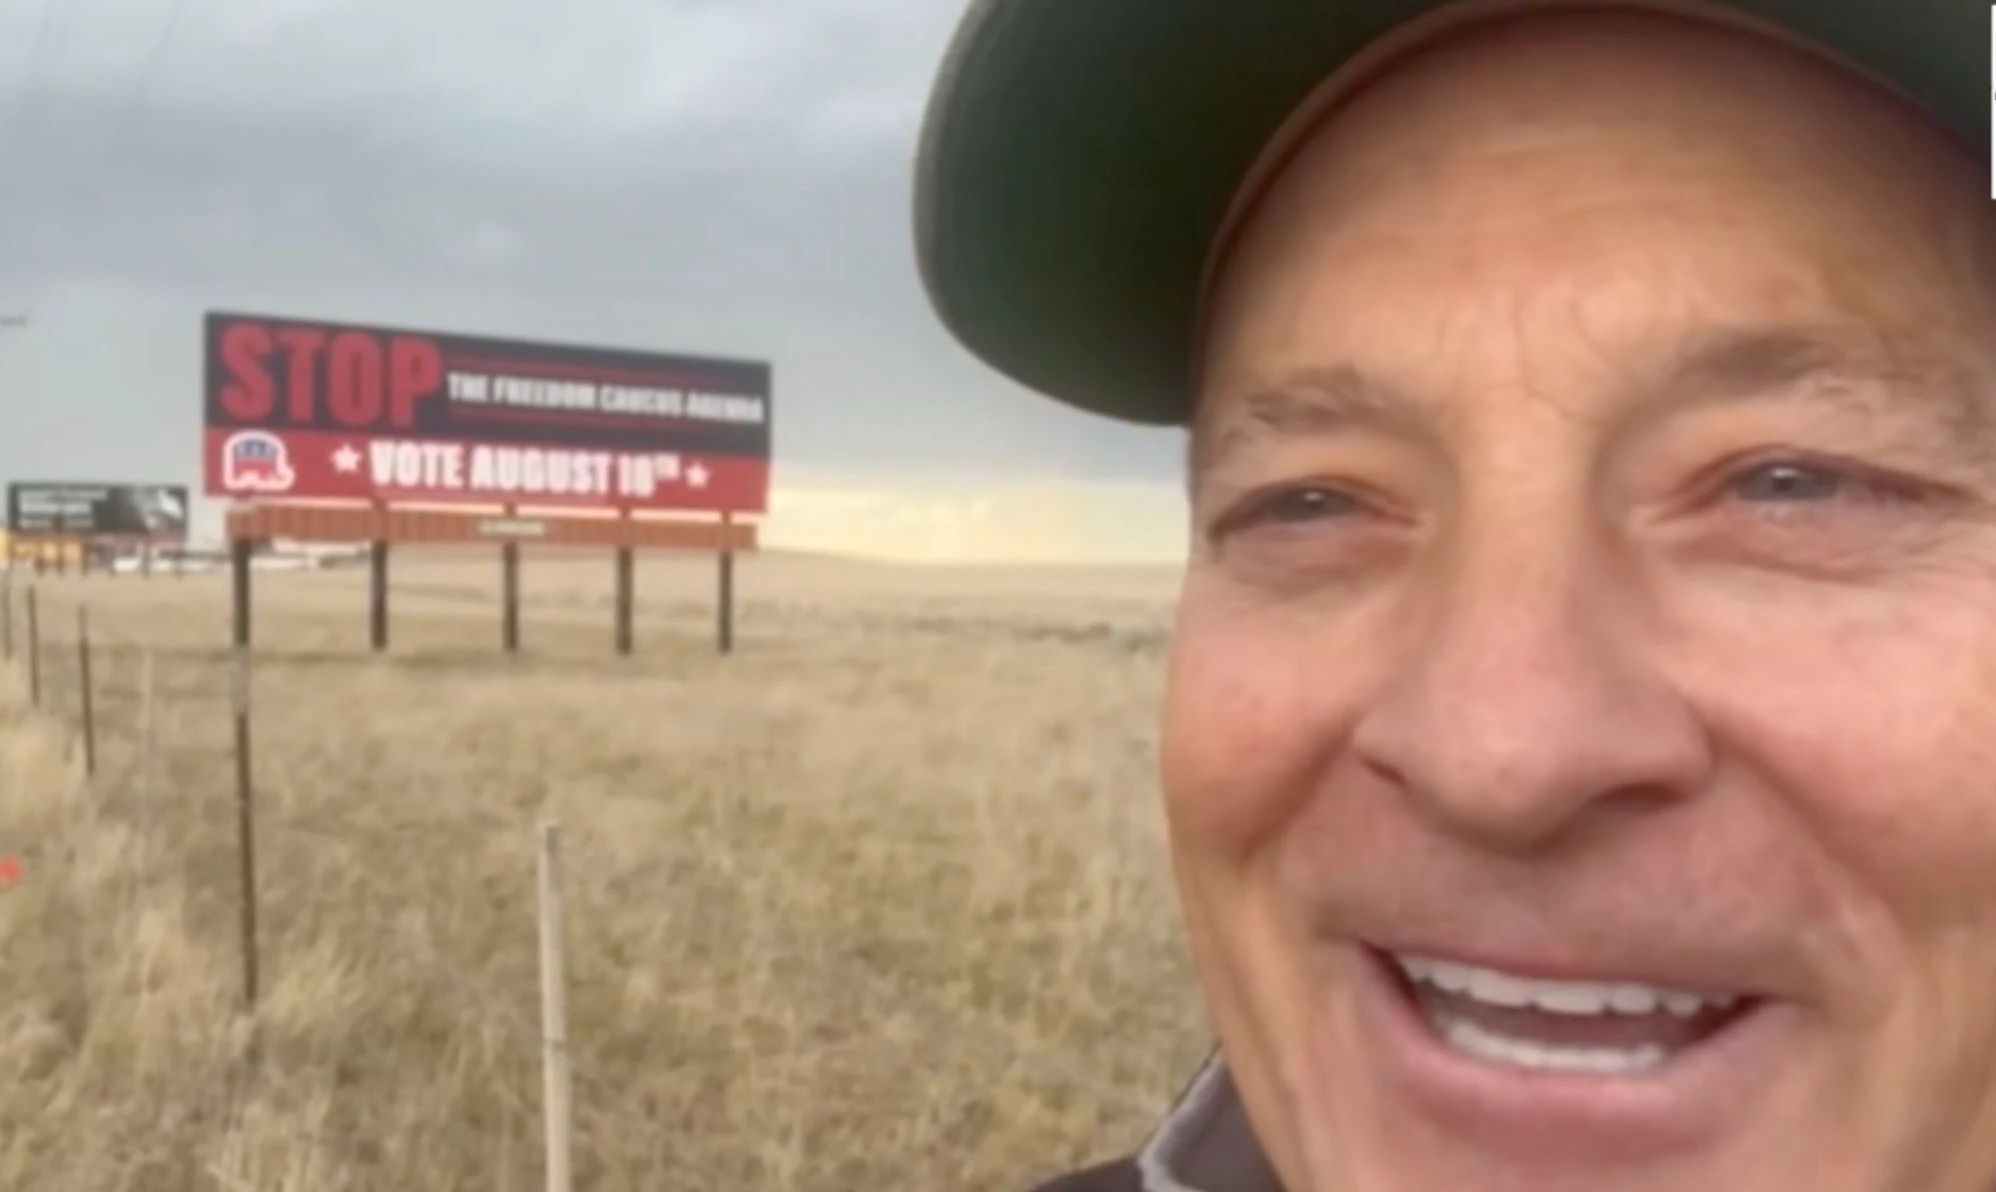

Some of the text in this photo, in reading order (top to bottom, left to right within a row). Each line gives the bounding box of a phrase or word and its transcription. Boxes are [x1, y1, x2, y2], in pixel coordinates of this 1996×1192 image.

[219, 322, 442, 426] STOP
[447, 372, 490, 403] THE
[493, 375, 596, 409] FREEDOM
[600, 384, 682, 417] CAUCUS
[369, 443, 462, 489] VOTE
[470, 446, 609, 496] AUGUST
